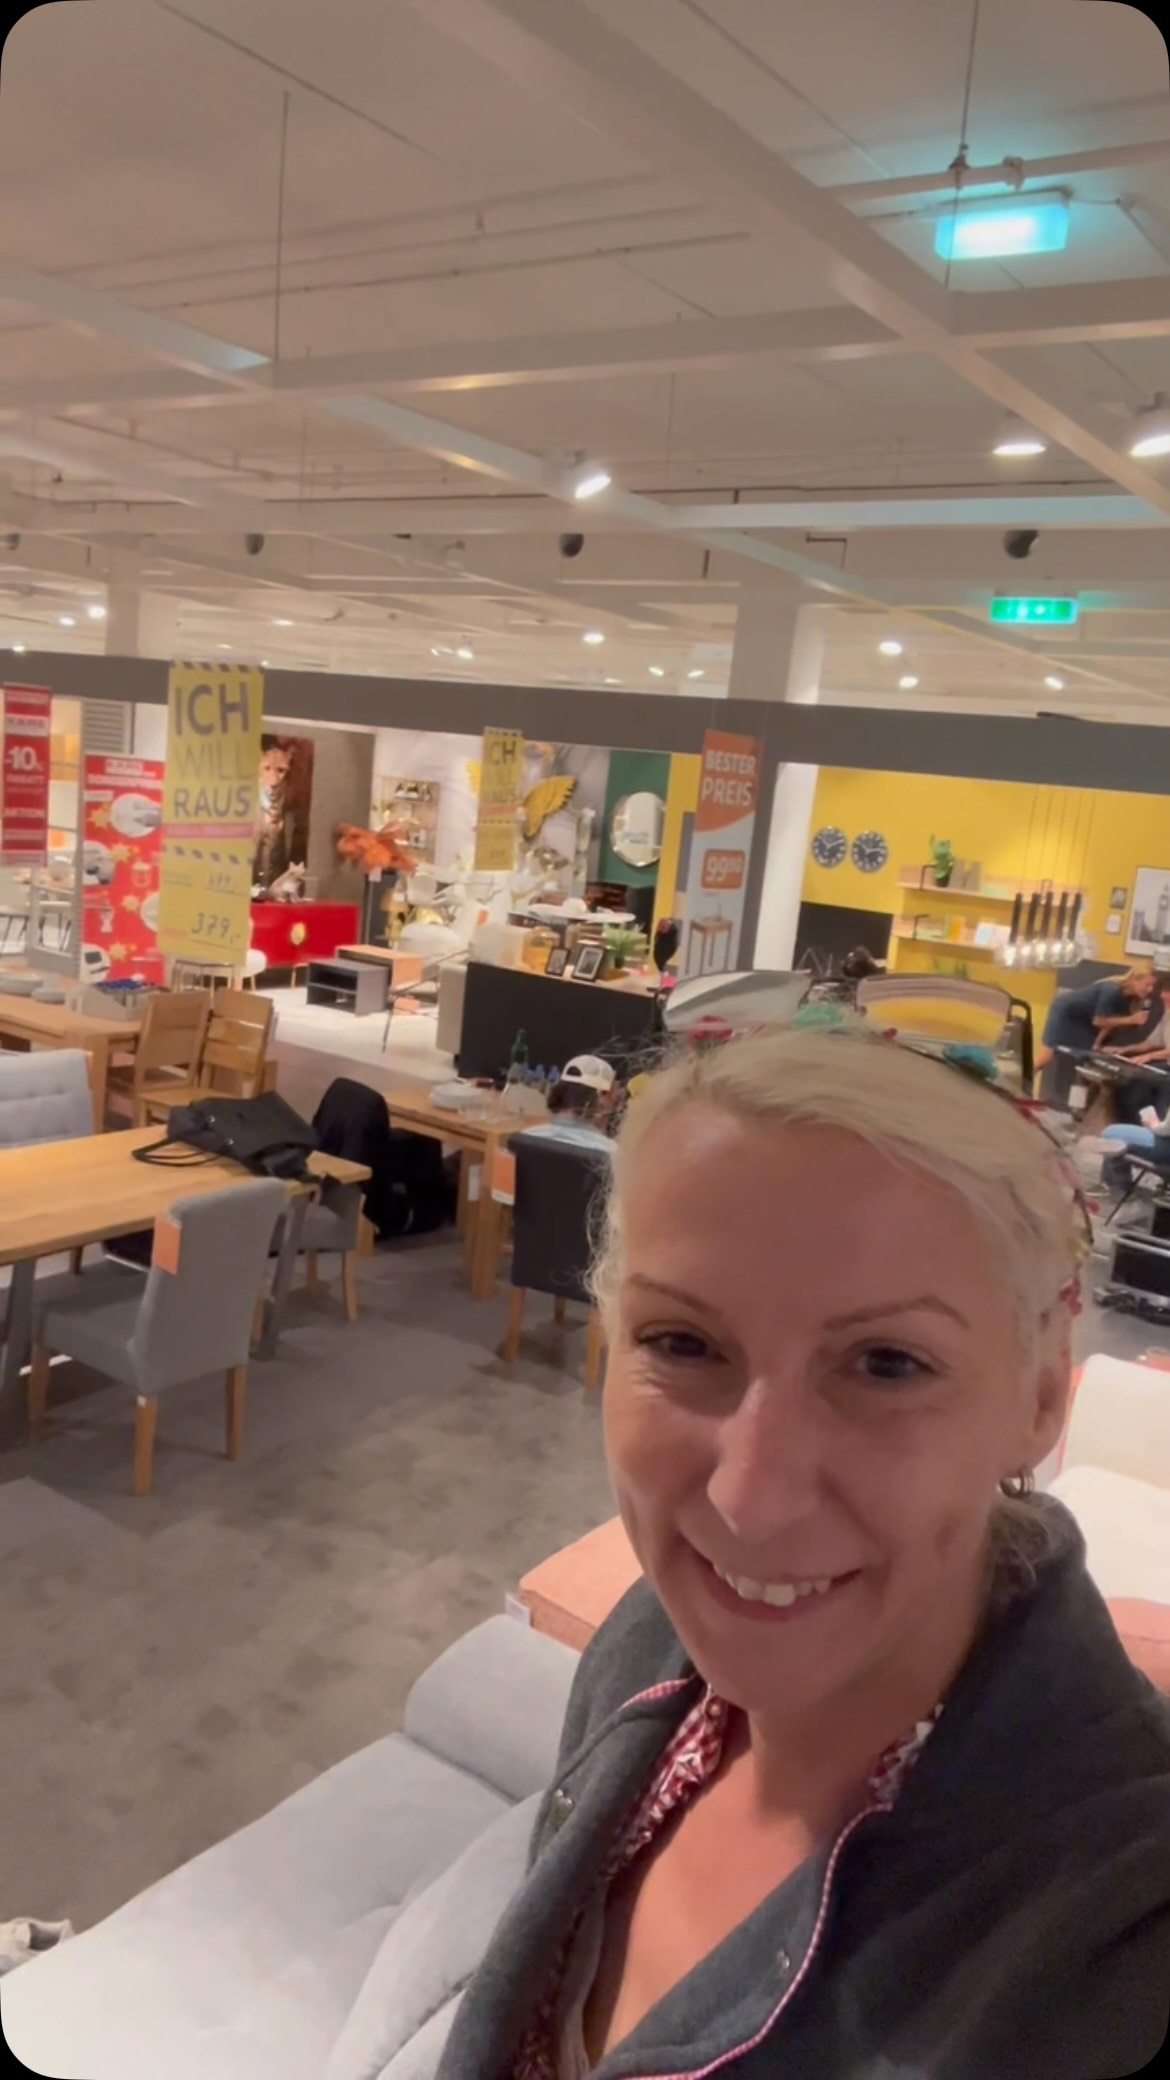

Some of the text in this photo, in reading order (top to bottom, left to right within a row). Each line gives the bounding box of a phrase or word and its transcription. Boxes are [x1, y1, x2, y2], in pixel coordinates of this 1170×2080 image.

[174, 682, 250, 736] ICH
[174, 742, 254, 781] WILL
[706, 749, 757, 776] BESTER
[174, 785, 251, 818] RAUS
[702, 776, 753, 806] PREIS
